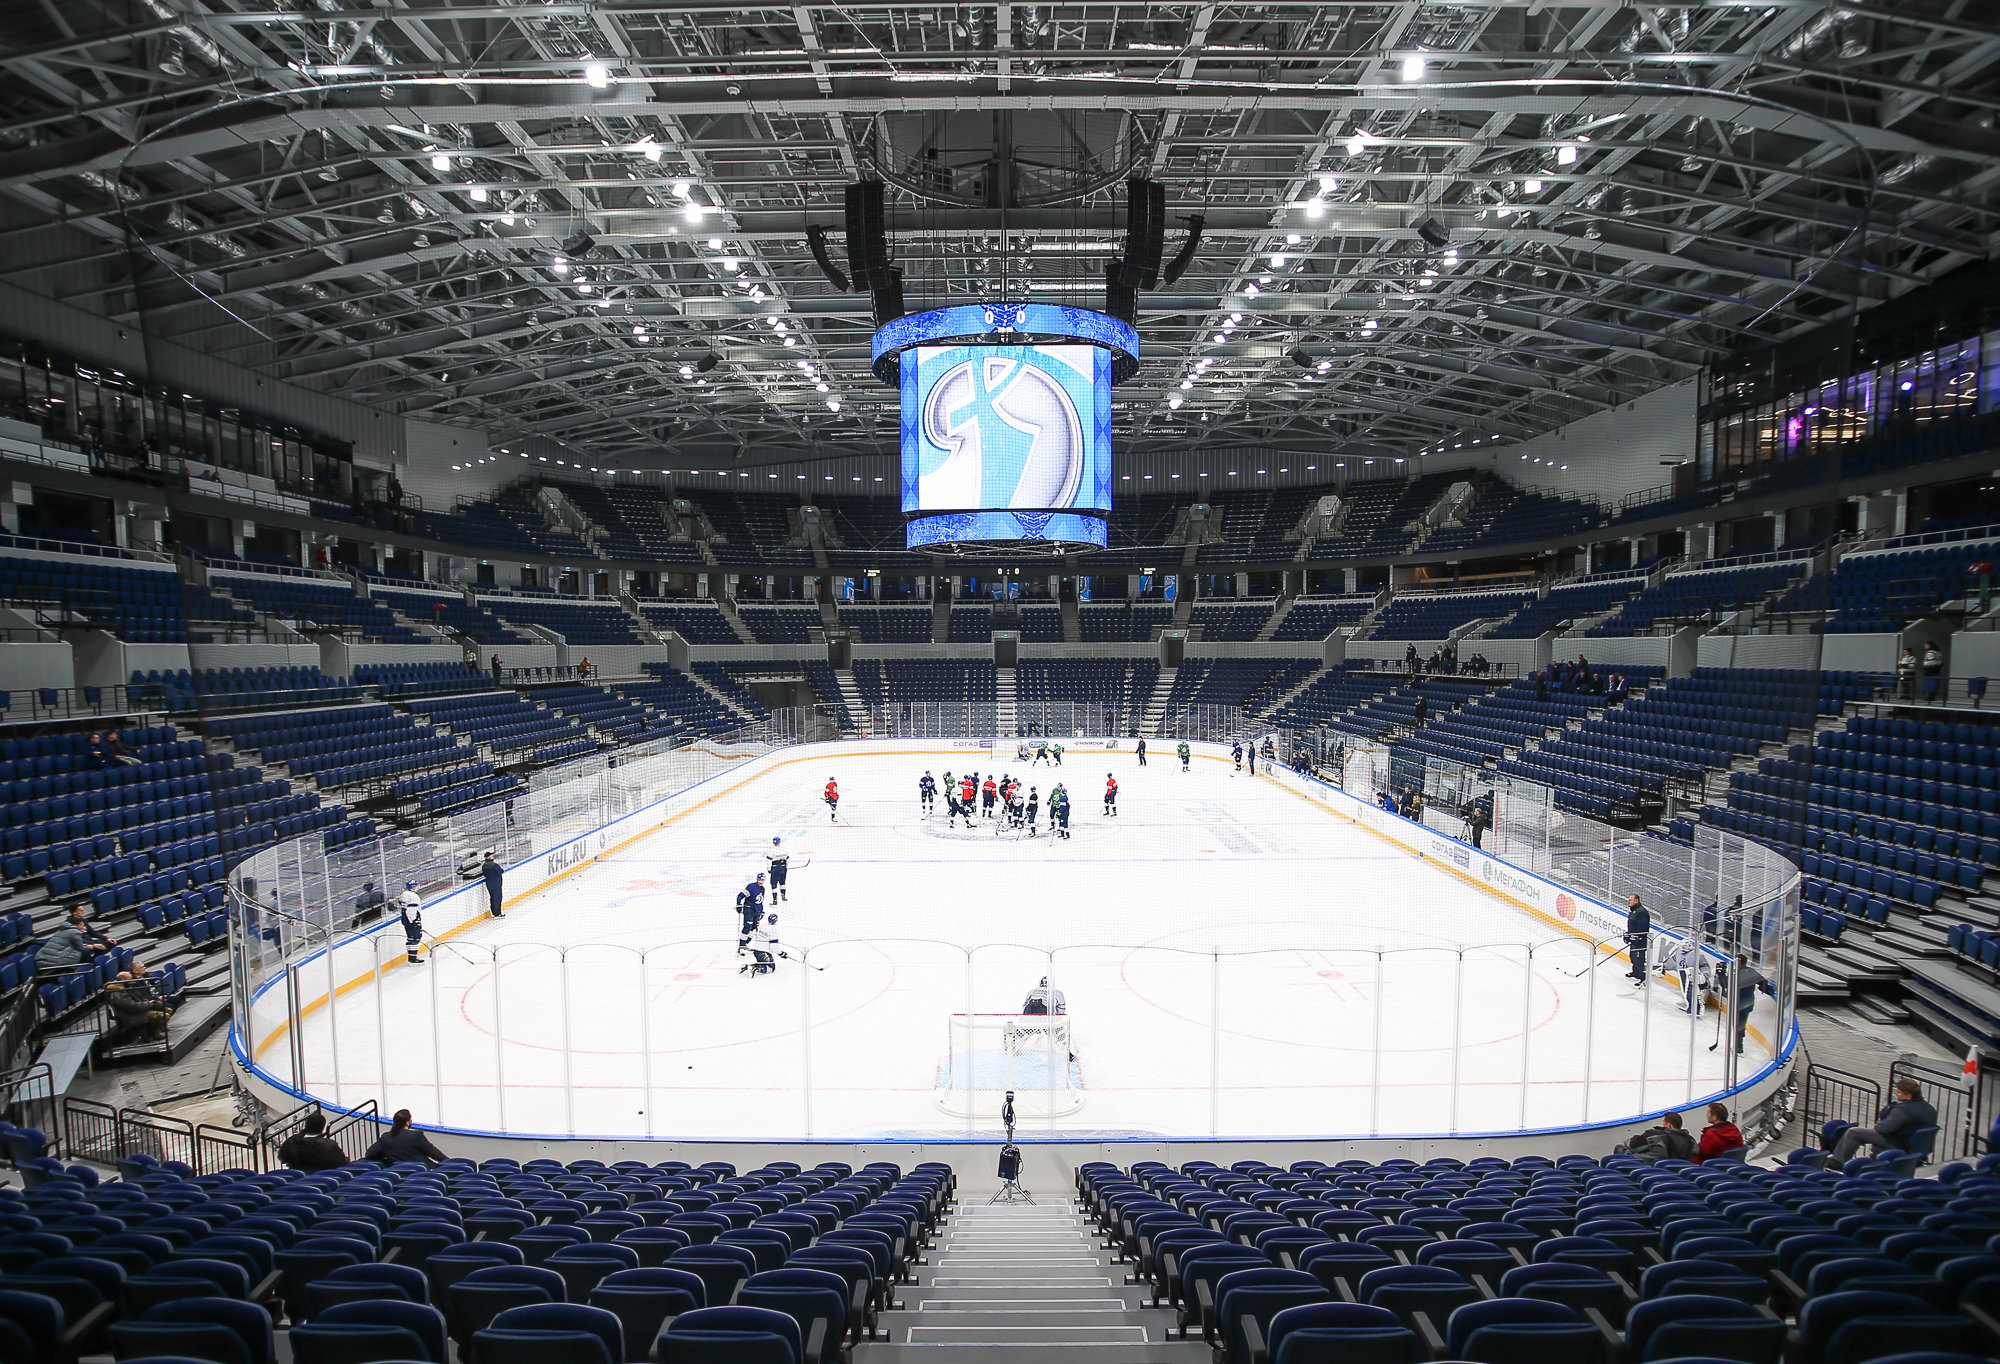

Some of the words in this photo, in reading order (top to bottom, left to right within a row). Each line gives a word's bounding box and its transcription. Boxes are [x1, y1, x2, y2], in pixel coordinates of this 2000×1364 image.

[984, 310, 994, 325] 0
[1016, 310, 1026, 324] 0
[997, 567, 1003, 575] 0
[1014, 567, 1020, 575] 0
[547, 839, 588, 876] KHL.RU
[1579, 909, 1628, 938] mastercar
